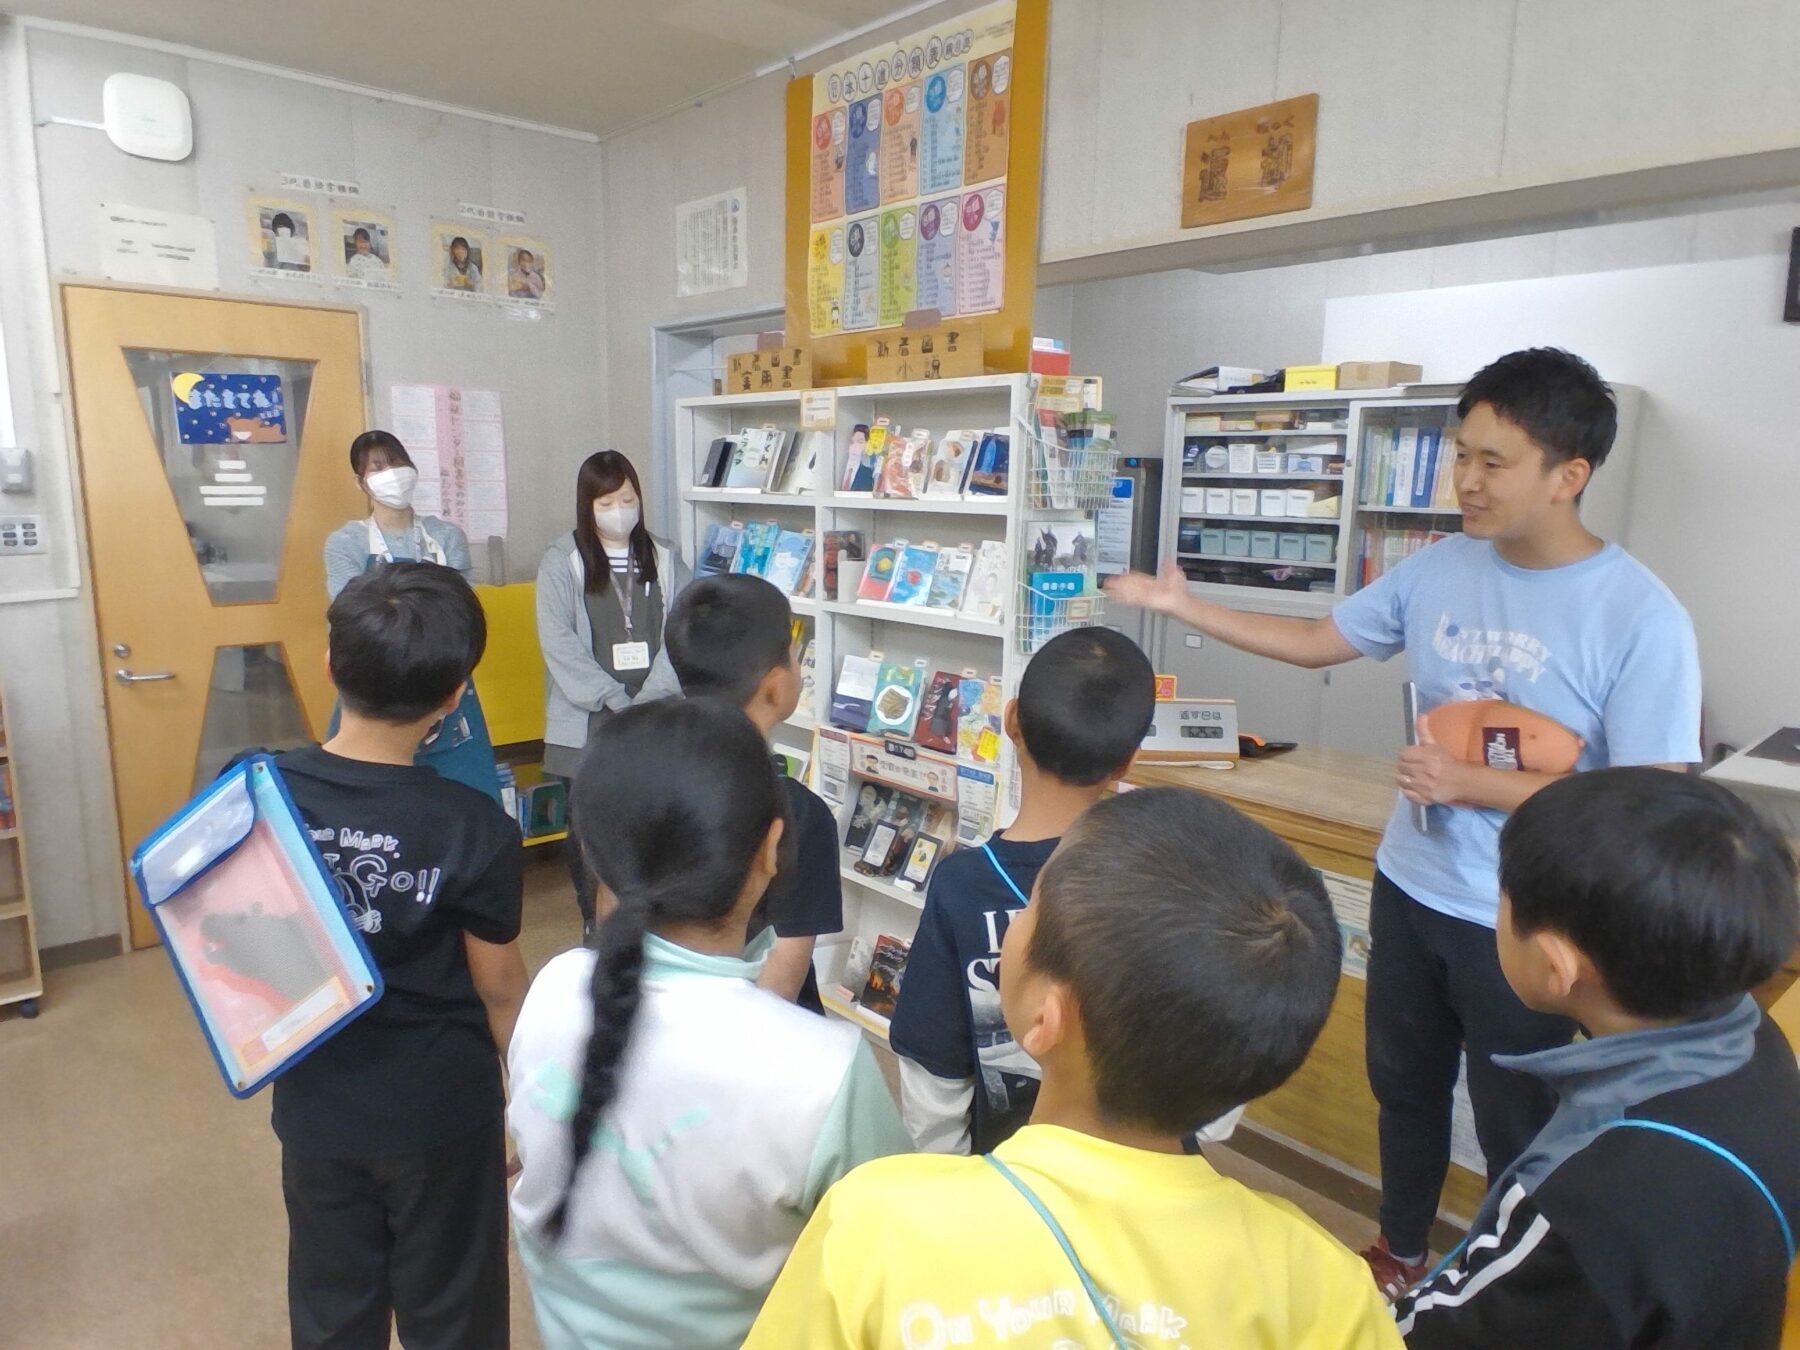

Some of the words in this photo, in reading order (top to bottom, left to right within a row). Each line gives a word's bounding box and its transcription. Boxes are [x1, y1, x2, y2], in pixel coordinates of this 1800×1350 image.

[829, 38, 942, 102] 日本十進分類表
[876, 331, 960, 358] 新着図書
[741, 365, 793, 391] 実用書
[897, 358, 941, 379] 小説
